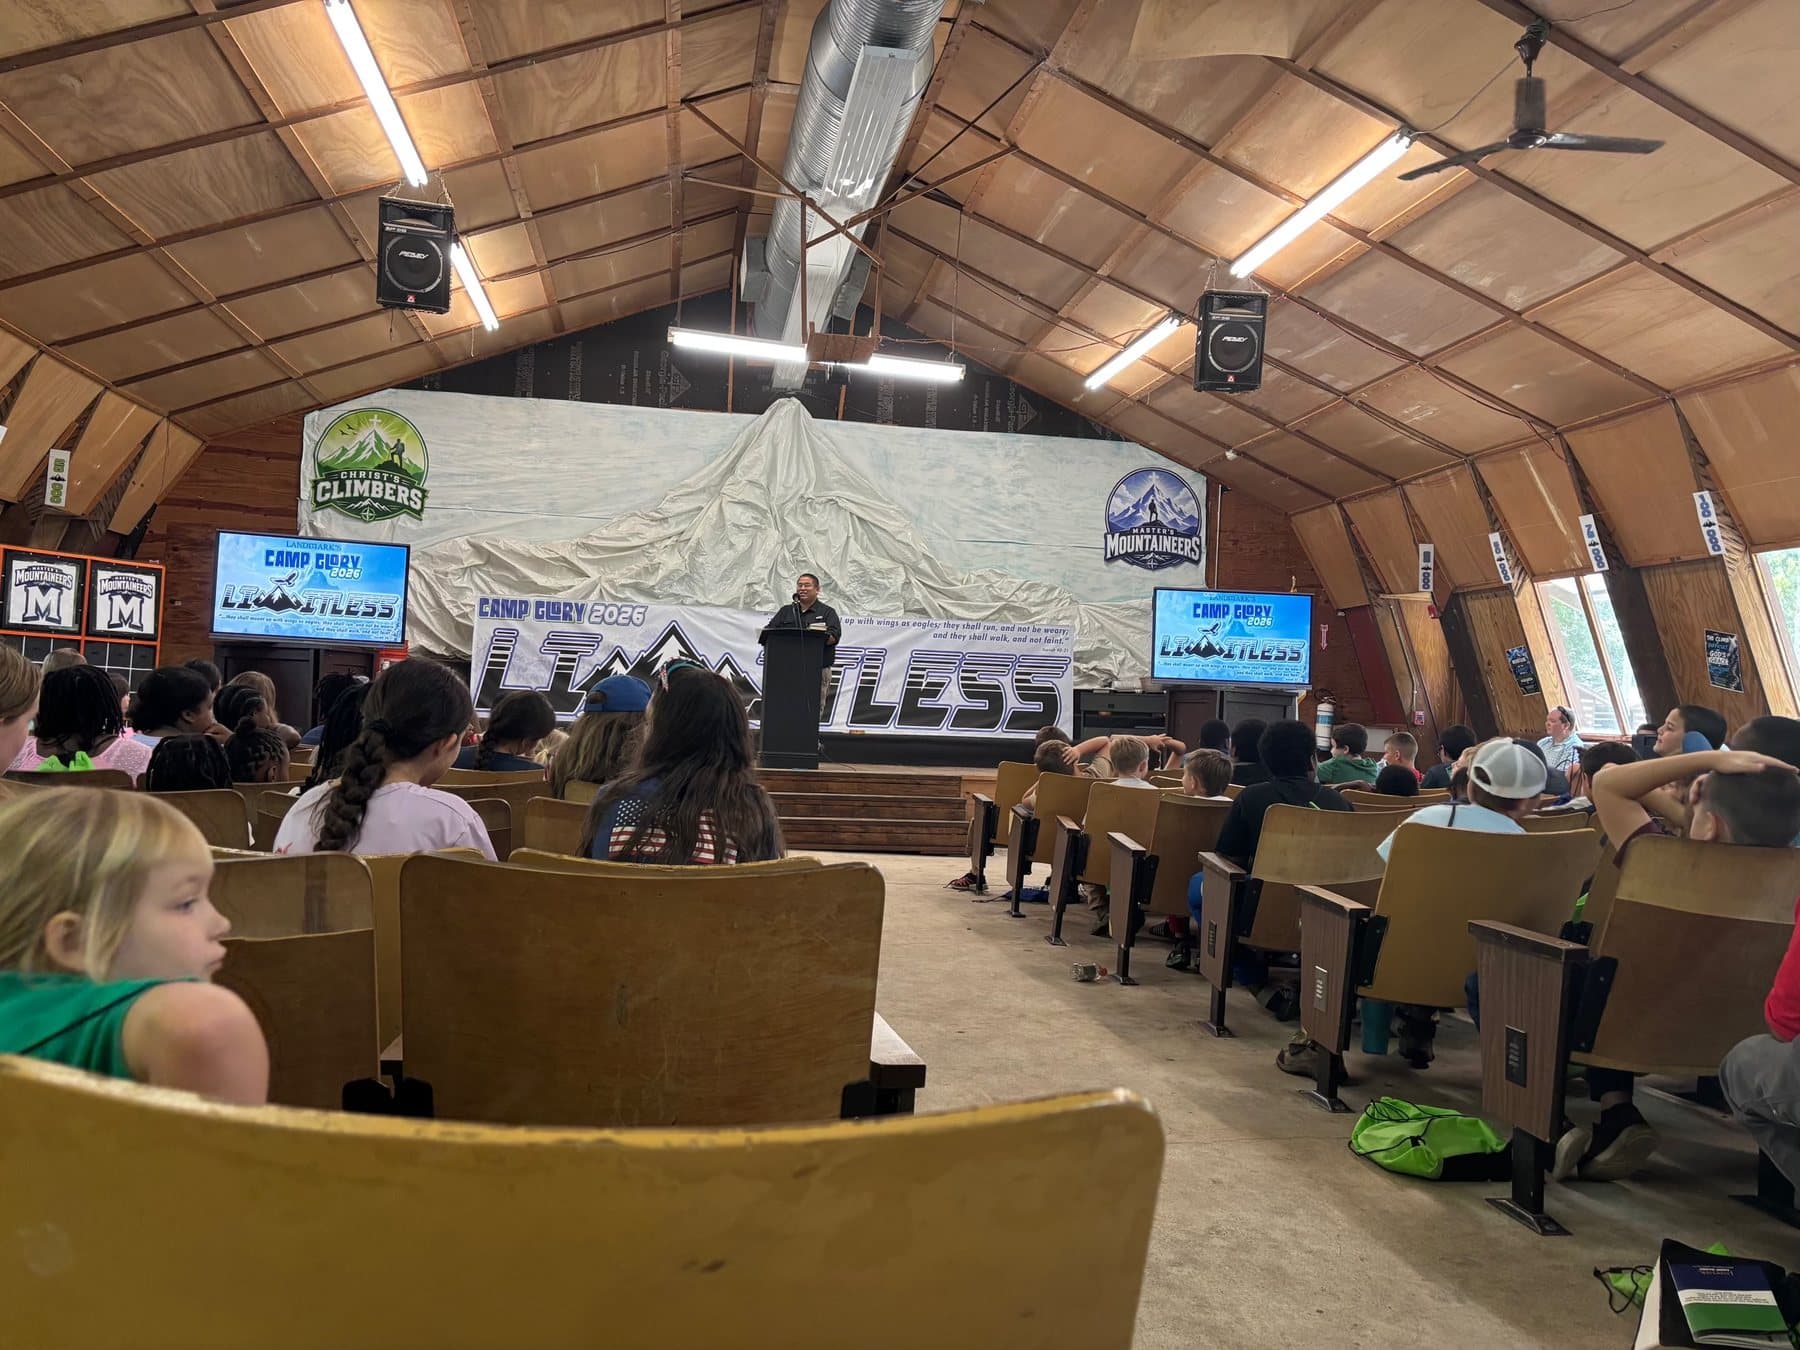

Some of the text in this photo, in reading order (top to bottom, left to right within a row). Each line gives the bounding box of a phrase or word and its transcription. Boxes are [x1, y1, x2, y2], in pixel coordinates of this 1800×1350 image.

[340, 470, 400, 483] CHRIST'S
[316, 479, 423, 511] CLIMBERS
[1698, 494, 1711, 518] 100
[1132, 527, 1175, 535] MASTER'S
[1106, 533, 1200, 561] MOUNTAINEERS
[265, 550, 361, 571] CAMP GLORY
[15, 569, 73, 590] MOUNTAINEERS
[330, 568, 362, 580] 2026
[100, 579, 153, 599] MOUNTAINEERS
[22, 585, 63, 624] M
[108, 594, 145, 632] M
[479, 597, 649, 626] CAMP GLORY 2026
[1193, 603, 1272, 620] CAMP GLORY
[844, 618, 855, 626] up
[857, 617, 874, 625] with
[877, 617, 899, 627] wings
[943, 621, 959, 631] they
[962, 622, 981, 630] shall
[983, 624, 998, 632] run,
[1000, 624, 1015, 632] and
[1017, 624, 1030, 633] not
[1032, 625, 1041, 633] be
[1247, 617, 1273, 627] 2026
[933, 631, 948, 639] and
[950, 632, 966, 641] they
[1012, 635, 1027, 643] and
[1029, 635, 1042, 643] not
